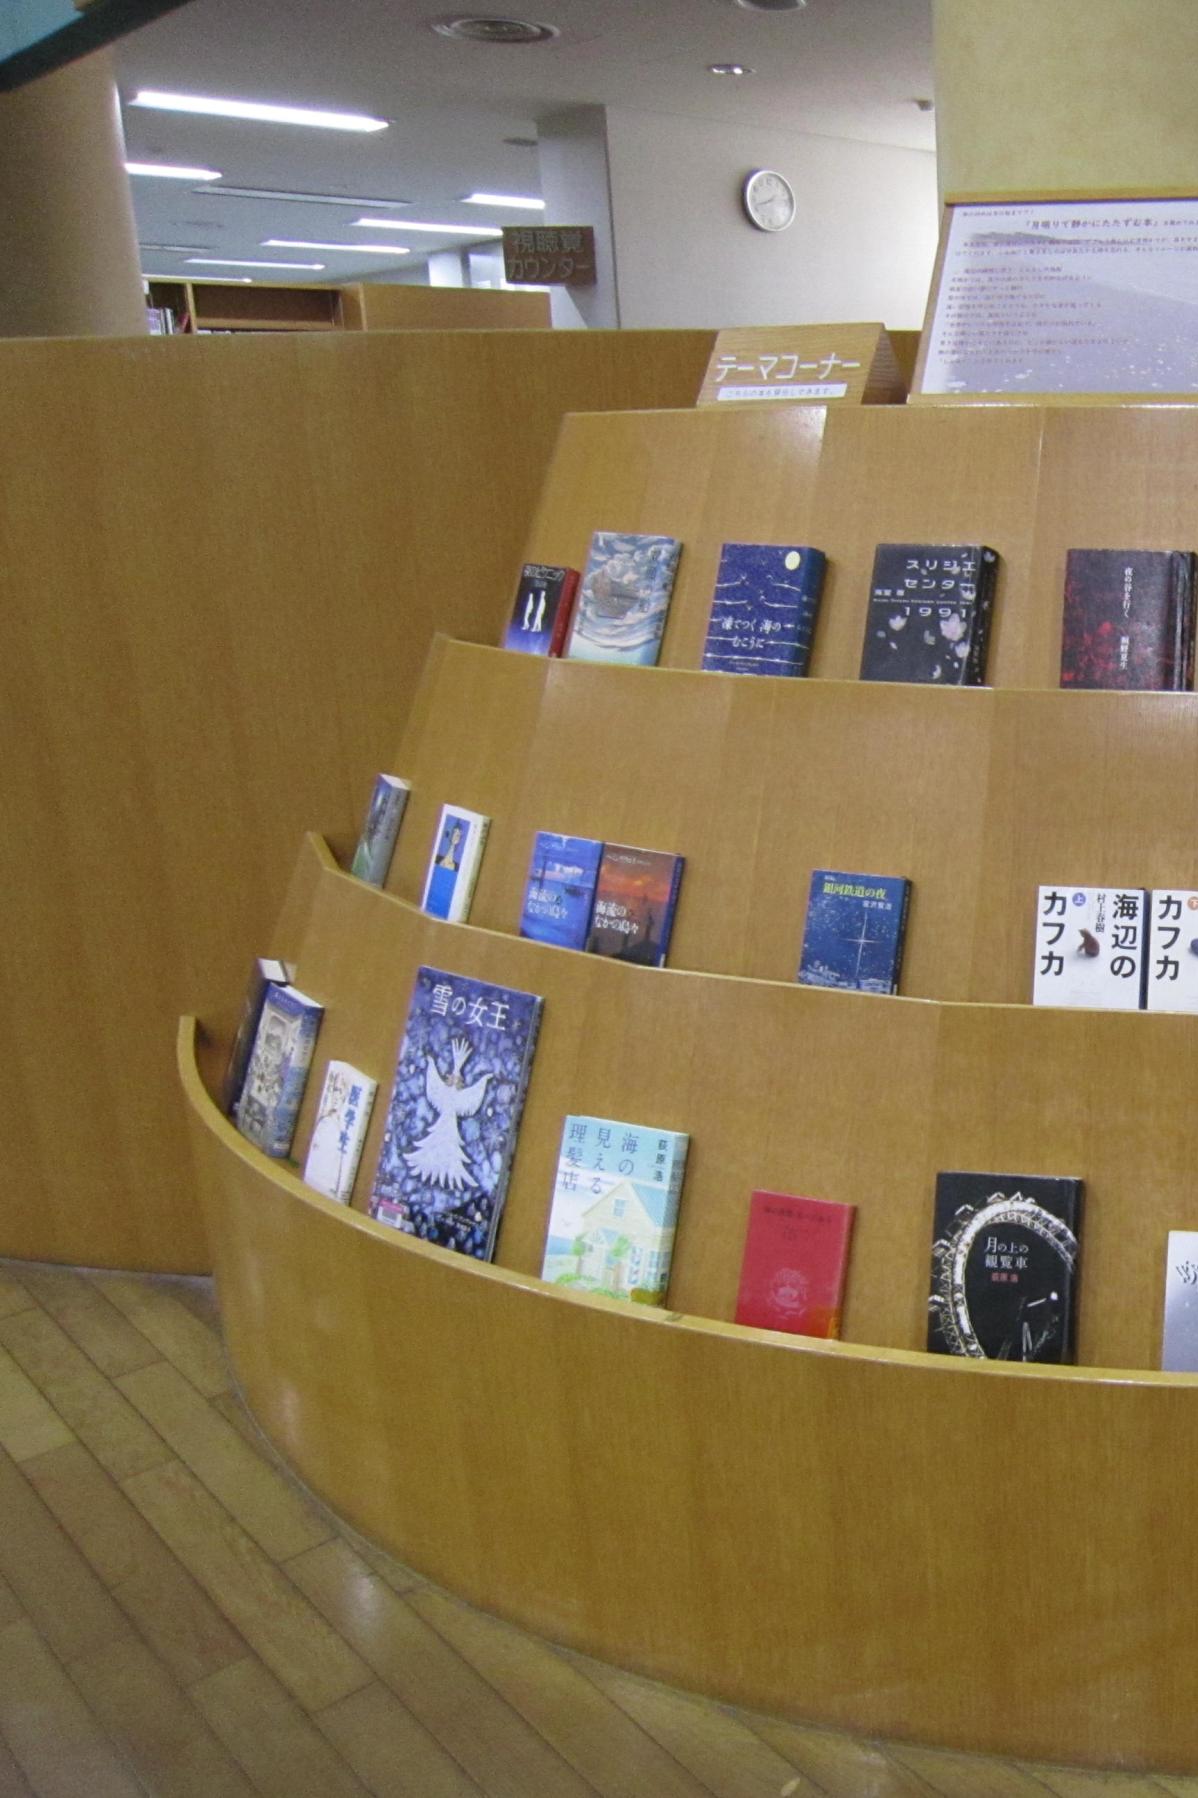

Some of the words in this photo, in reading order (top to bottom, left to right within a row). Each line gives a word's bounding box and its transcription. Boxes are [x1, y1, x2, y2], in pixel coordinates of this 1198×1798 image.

[511, 230, 585, 253] 視聴覚
[508, 255, 591, 278] カウンター
[716, 352, 861, 382] テーマコーナー
[906, 558, 976, 572] スリジエ
[904, 578, 976, 590] センター
[904, 606, 967, 618] 1991
[732, 636, 766, 650] むこうに
[1040, 891, 1067, 976] カフカ
[1110, 893, 1139, 979] 海辺の
[1155, 895, 1183, 981] カフカ
[431, 983, 510, 1031] 雪の女王
[561, 1123, 587, 1191] 理髪店
[590, 1127, 611, 1195] 見える
[618, 1132, 639, 1176] 海の
[983, 1236, 1029, 1254] 月の上の
[984, 1254, 1028, 1269] 観覧車
